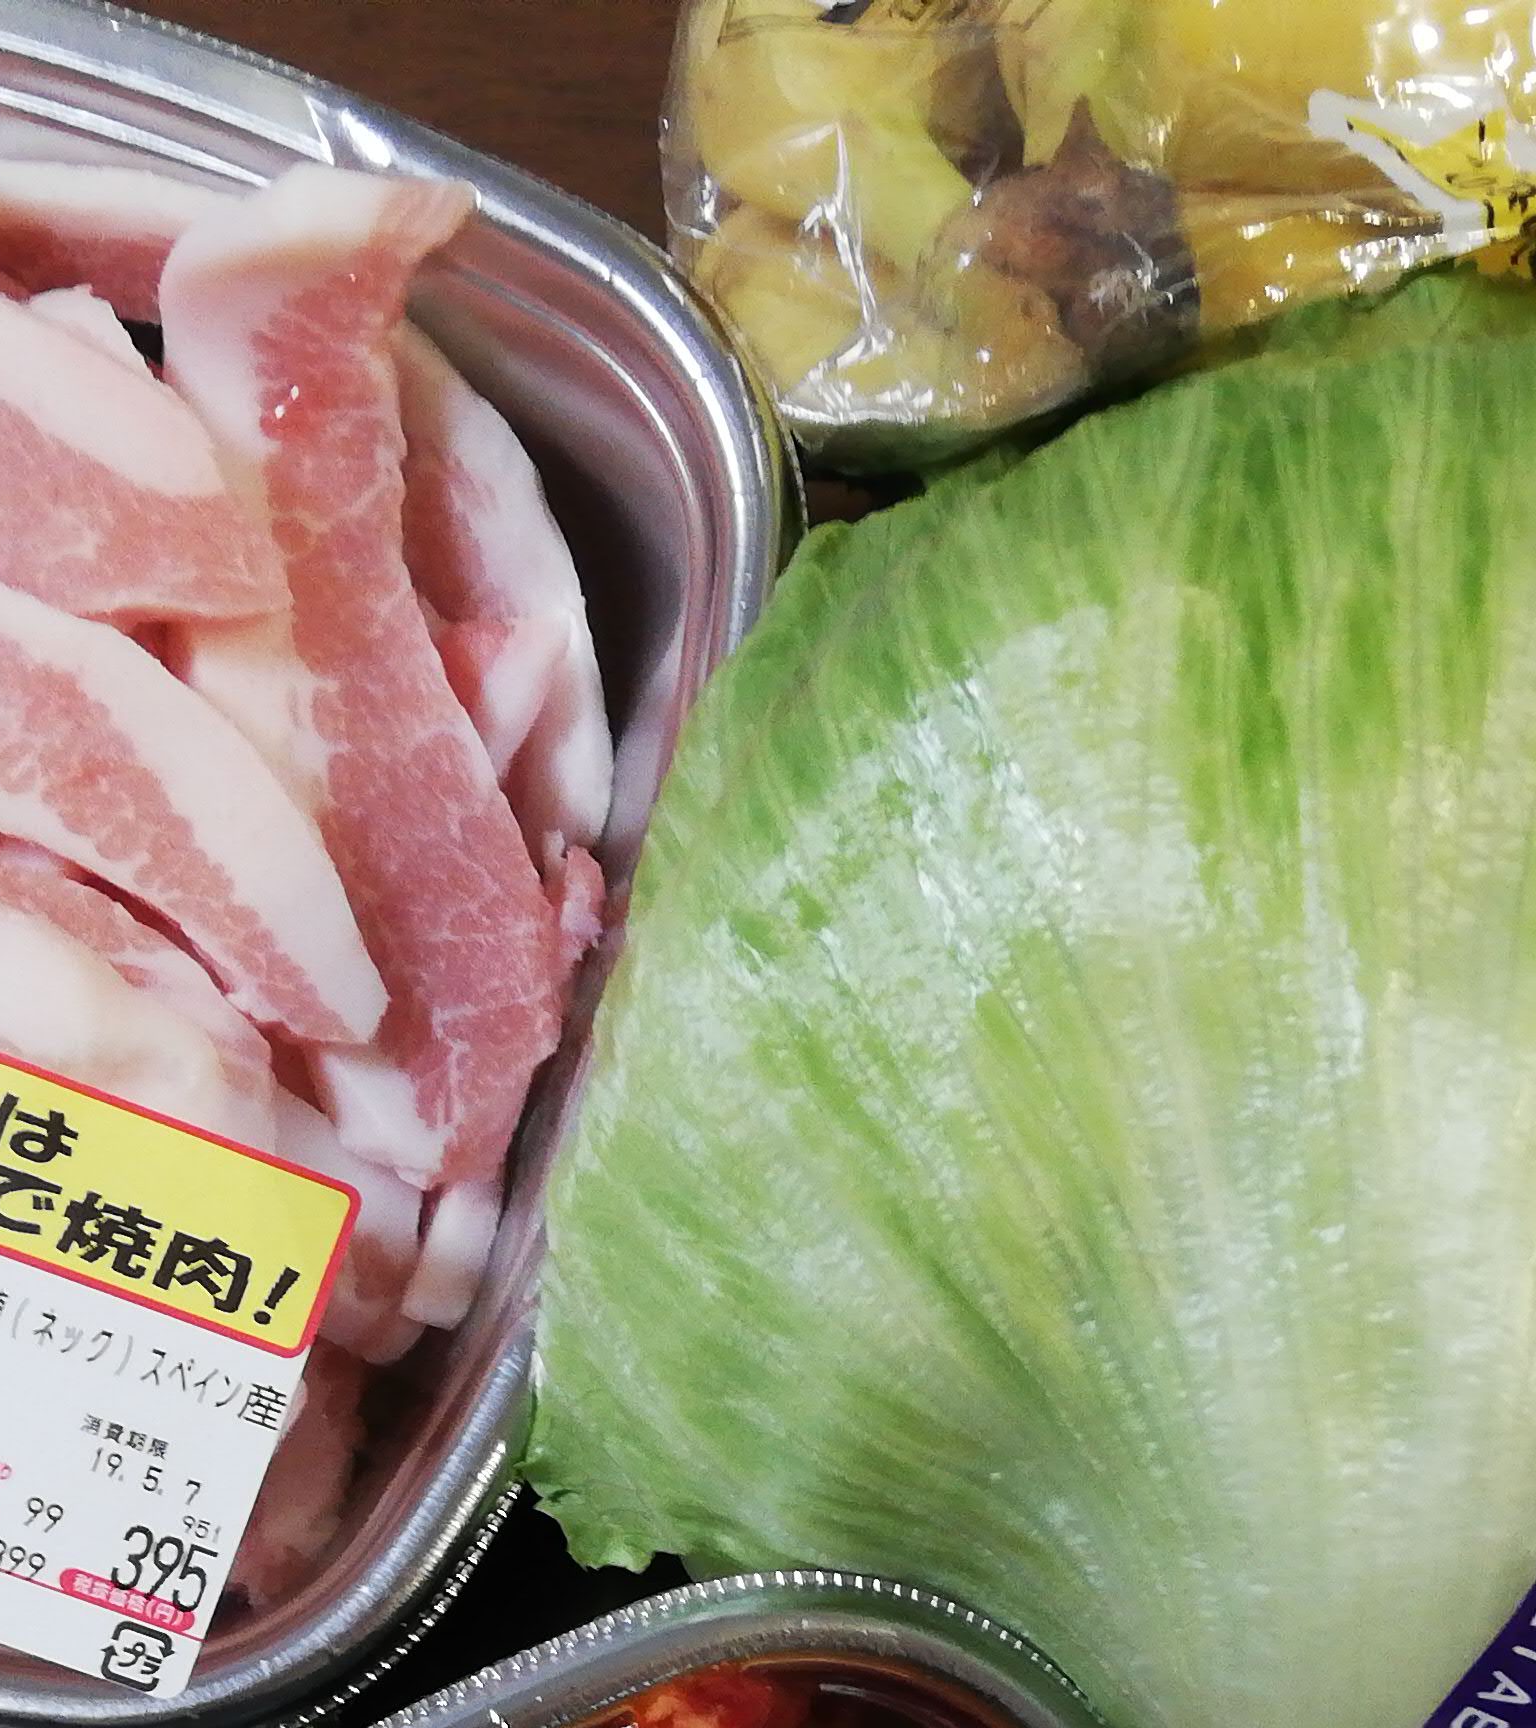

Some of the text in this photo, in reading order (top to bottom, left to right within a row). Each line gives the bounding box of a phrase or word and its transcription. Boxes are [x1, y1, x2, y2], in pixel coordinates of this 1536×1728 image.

[80, 1413, 171, 1459] 消費期限
[23, 1496, 64, 1534] 99
[111, 1525, 218, 1613] 395
